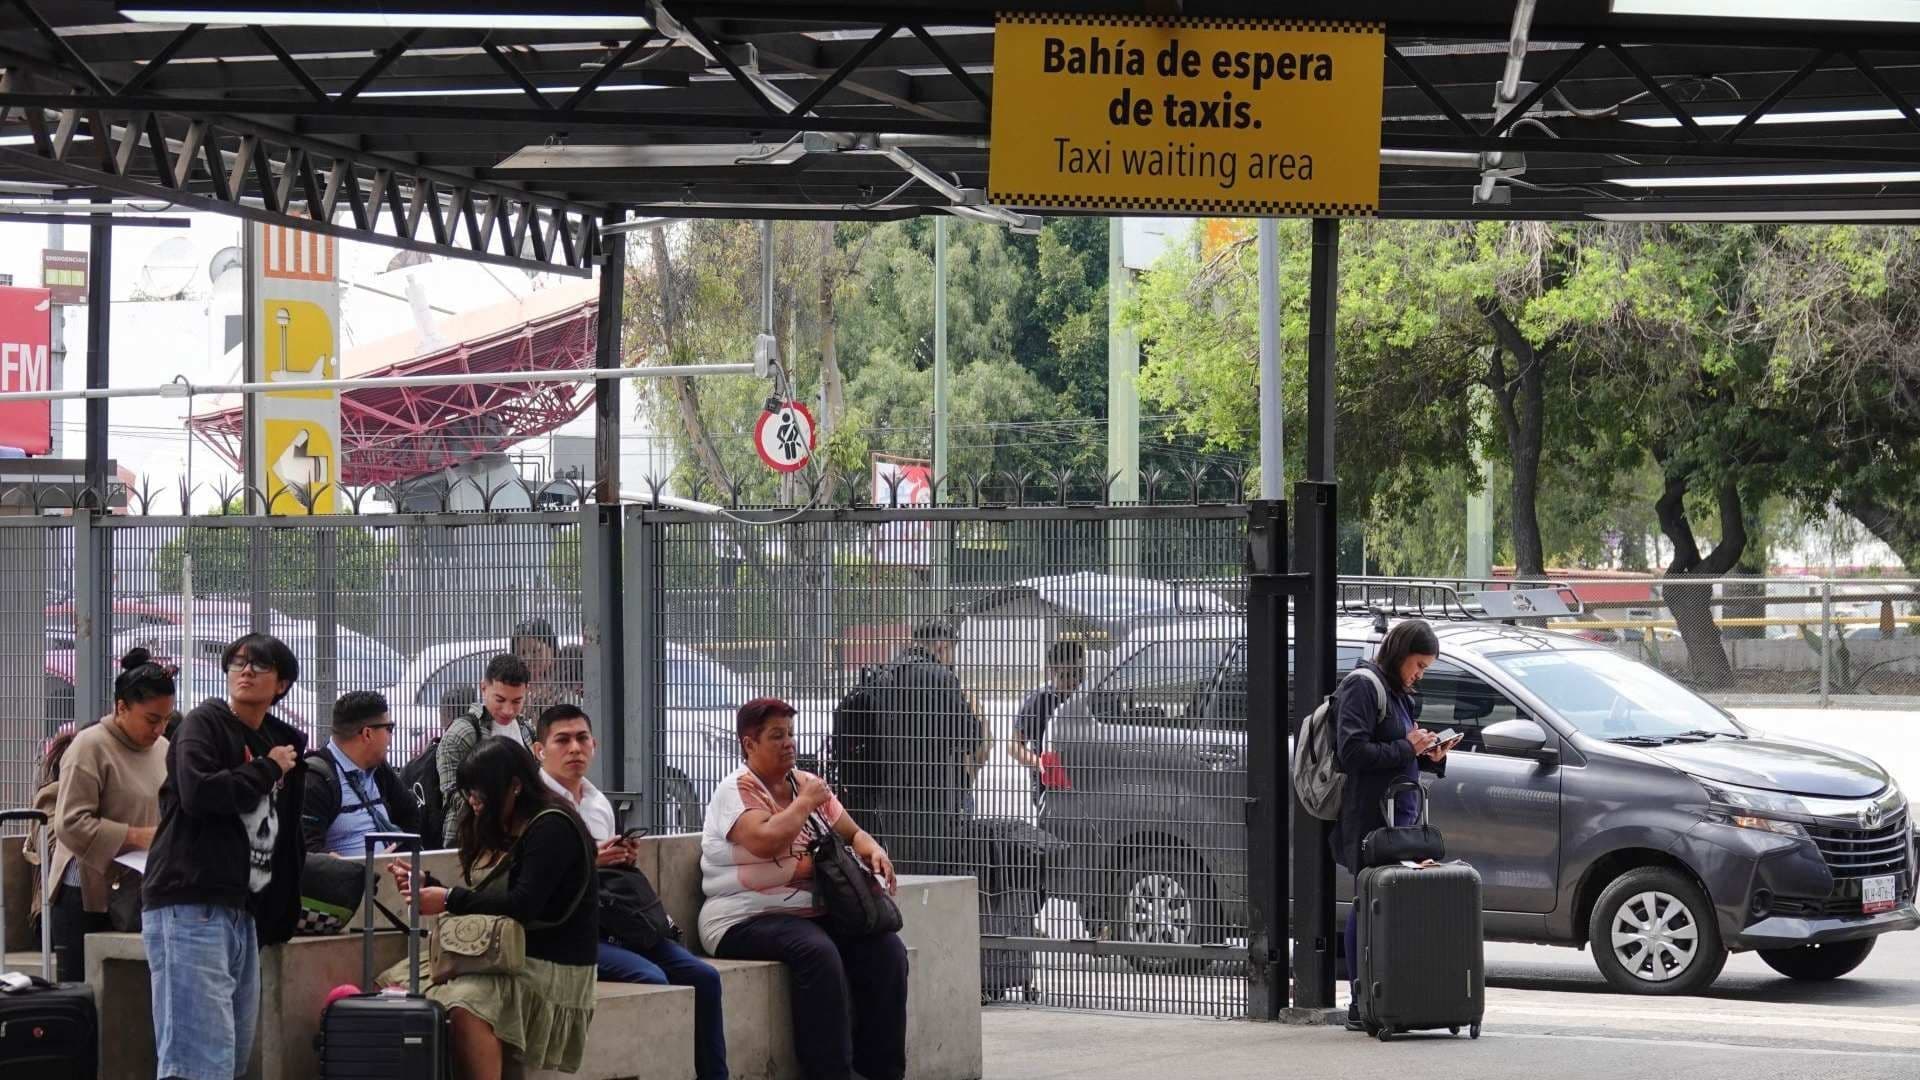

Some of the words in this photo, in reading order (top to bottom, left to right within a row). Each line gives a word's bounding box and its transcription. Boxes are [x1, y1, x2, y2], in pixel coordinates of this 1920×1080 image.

[1043, 37, 1145, 76] Bahía
[1156, 39, 1200, 77] de
[1212, 50, 1333, 90] espera
[1108, 88, 1152, 126] de
[1163, 91, 1262, 129] taxis.
[1054, 138, 1111, 175] Taxi
[1122, 142, 1237, 189] waiting
[1248, 153, 1314, 180] area
[1, 343, 48, 392] FM
